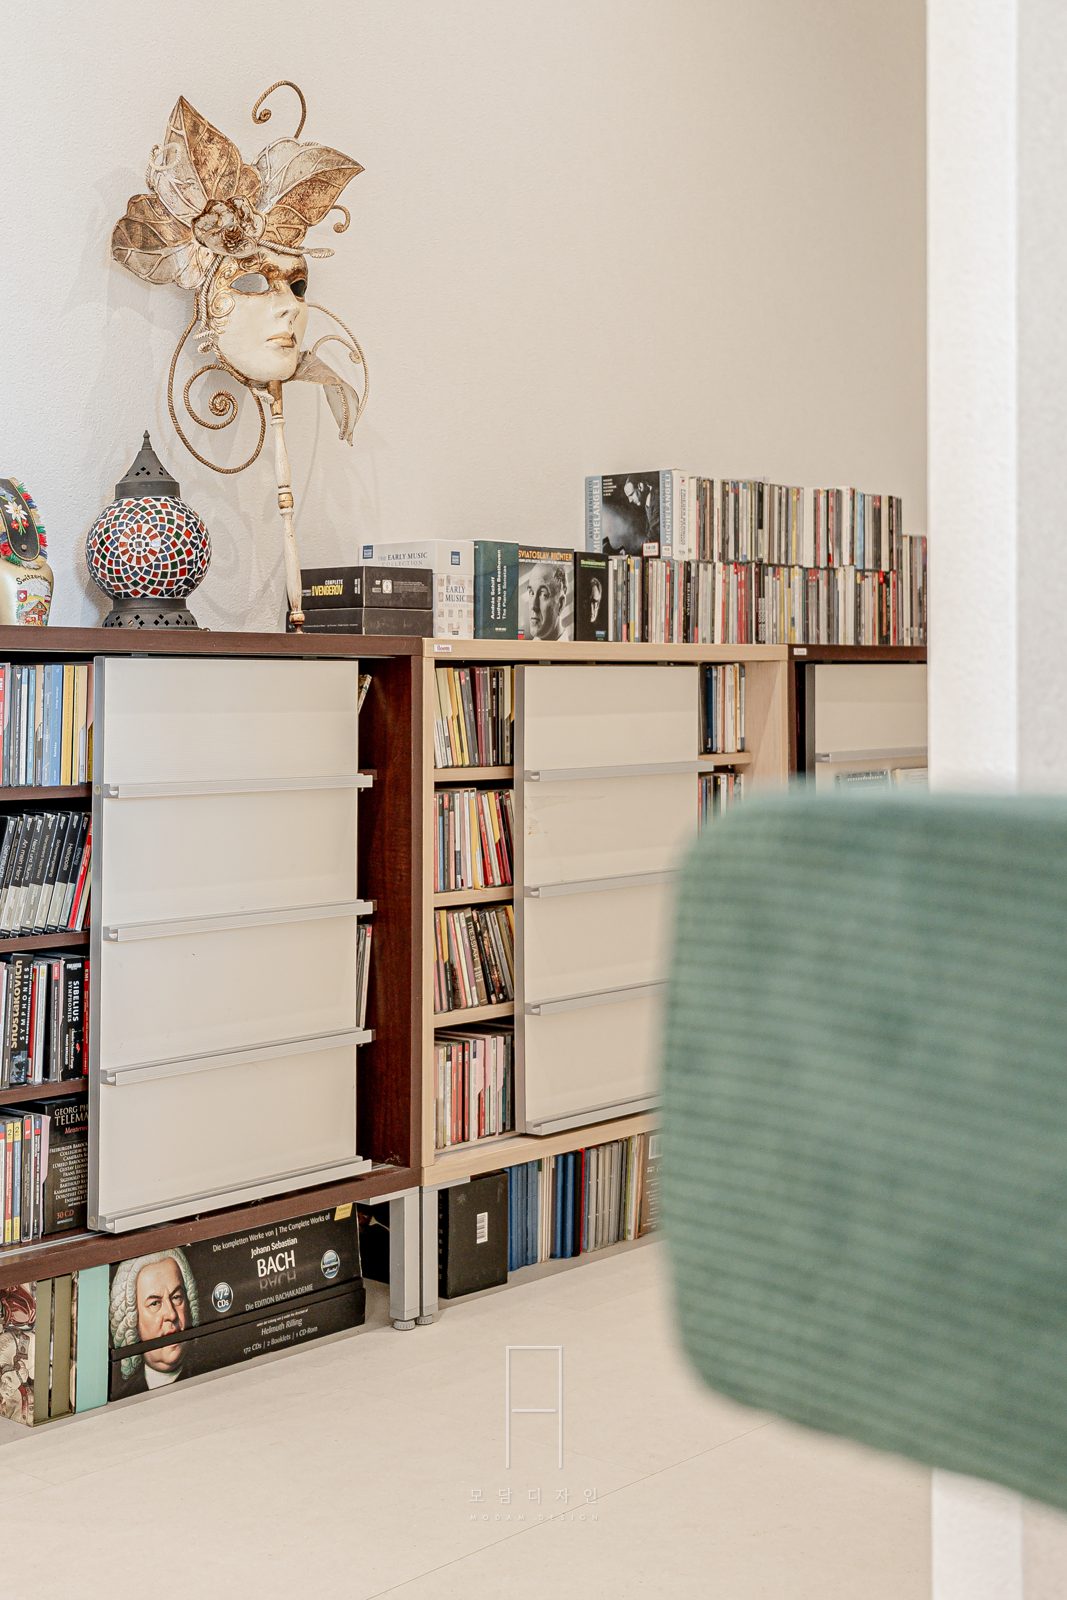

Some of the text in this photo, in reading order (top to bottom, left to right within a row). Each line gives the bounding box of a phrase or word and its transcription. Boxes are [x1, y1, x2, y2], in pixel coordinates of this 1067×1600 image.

[592, 479, 600, 552] MICHELANGELI
[518, 550, 549, 559] SVIATOSLAV
[550, 552, 572, 561] RICHTER
[315, 585, 343, 596] VENGEROV
[446, 586, 466, 594] EARLY
[445, 594, 466, 602] MUSIC
[22, 838, 28, 848] An
[63, 842, 74, 870] Heliopolis
[20, 967, 30, 1040] SYMPHONIES
[54, 1106, 78, 1116] GEORG
[57, 1212, 64, 1220] 30
[212, 1244, 221, 1252] Die
[222, 1236, 249, 1249] kompletten
[249, 1232, 264, 1242] Werke
[279, 1225, 288, 1234] The
[288, 1220, 310, 1231] Complete
[310, 1215, 324, 1225] Works
[250, 1237, 298, 1258] Johann Sebastian
[257, 1250, 296, 1278] BACH
[215, 1287, 229, 1300] 172
[254, 1296, 275, 1308] EDITION
[275, 1284, 314, 1302] BACHAKADEMIE
[217, 1299, 229, 1308] CDs
[261, 1318, 302, 1336] Helmuth Rilling
[252, 1343, 262, 1351] CDs
[271, 1334, 291, 1345] Booklets
[299, 1326, 318, 1337] CD-Rom
